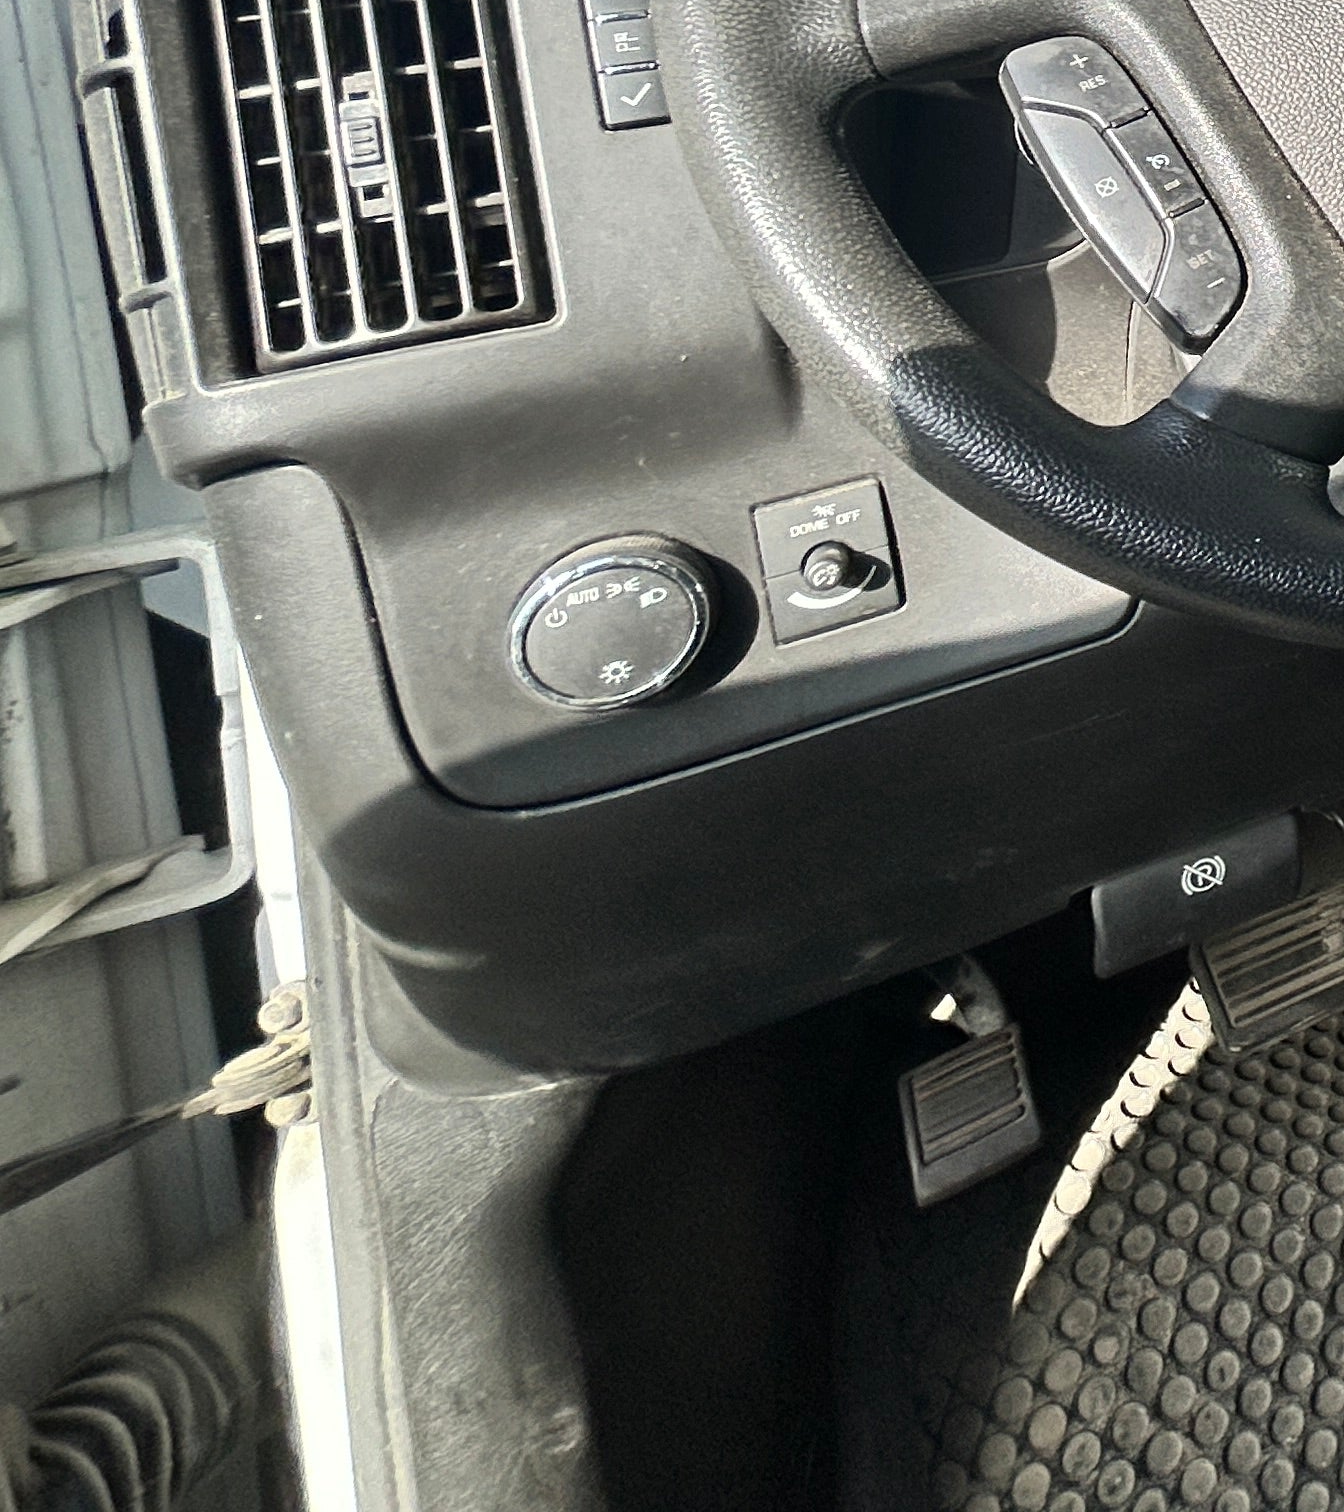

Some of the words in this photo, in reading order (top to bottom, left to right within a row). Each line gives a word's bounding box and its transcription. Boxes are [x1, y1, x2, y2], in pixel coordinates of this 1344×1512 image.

[1079, 74, 1107, 93] RES
[1186, 250, 1214, 270] SET
[789, 518, 830, 538] DOME
[835, 508, 861, 525] OFF
[566, 586, 600, 607] AUTO
